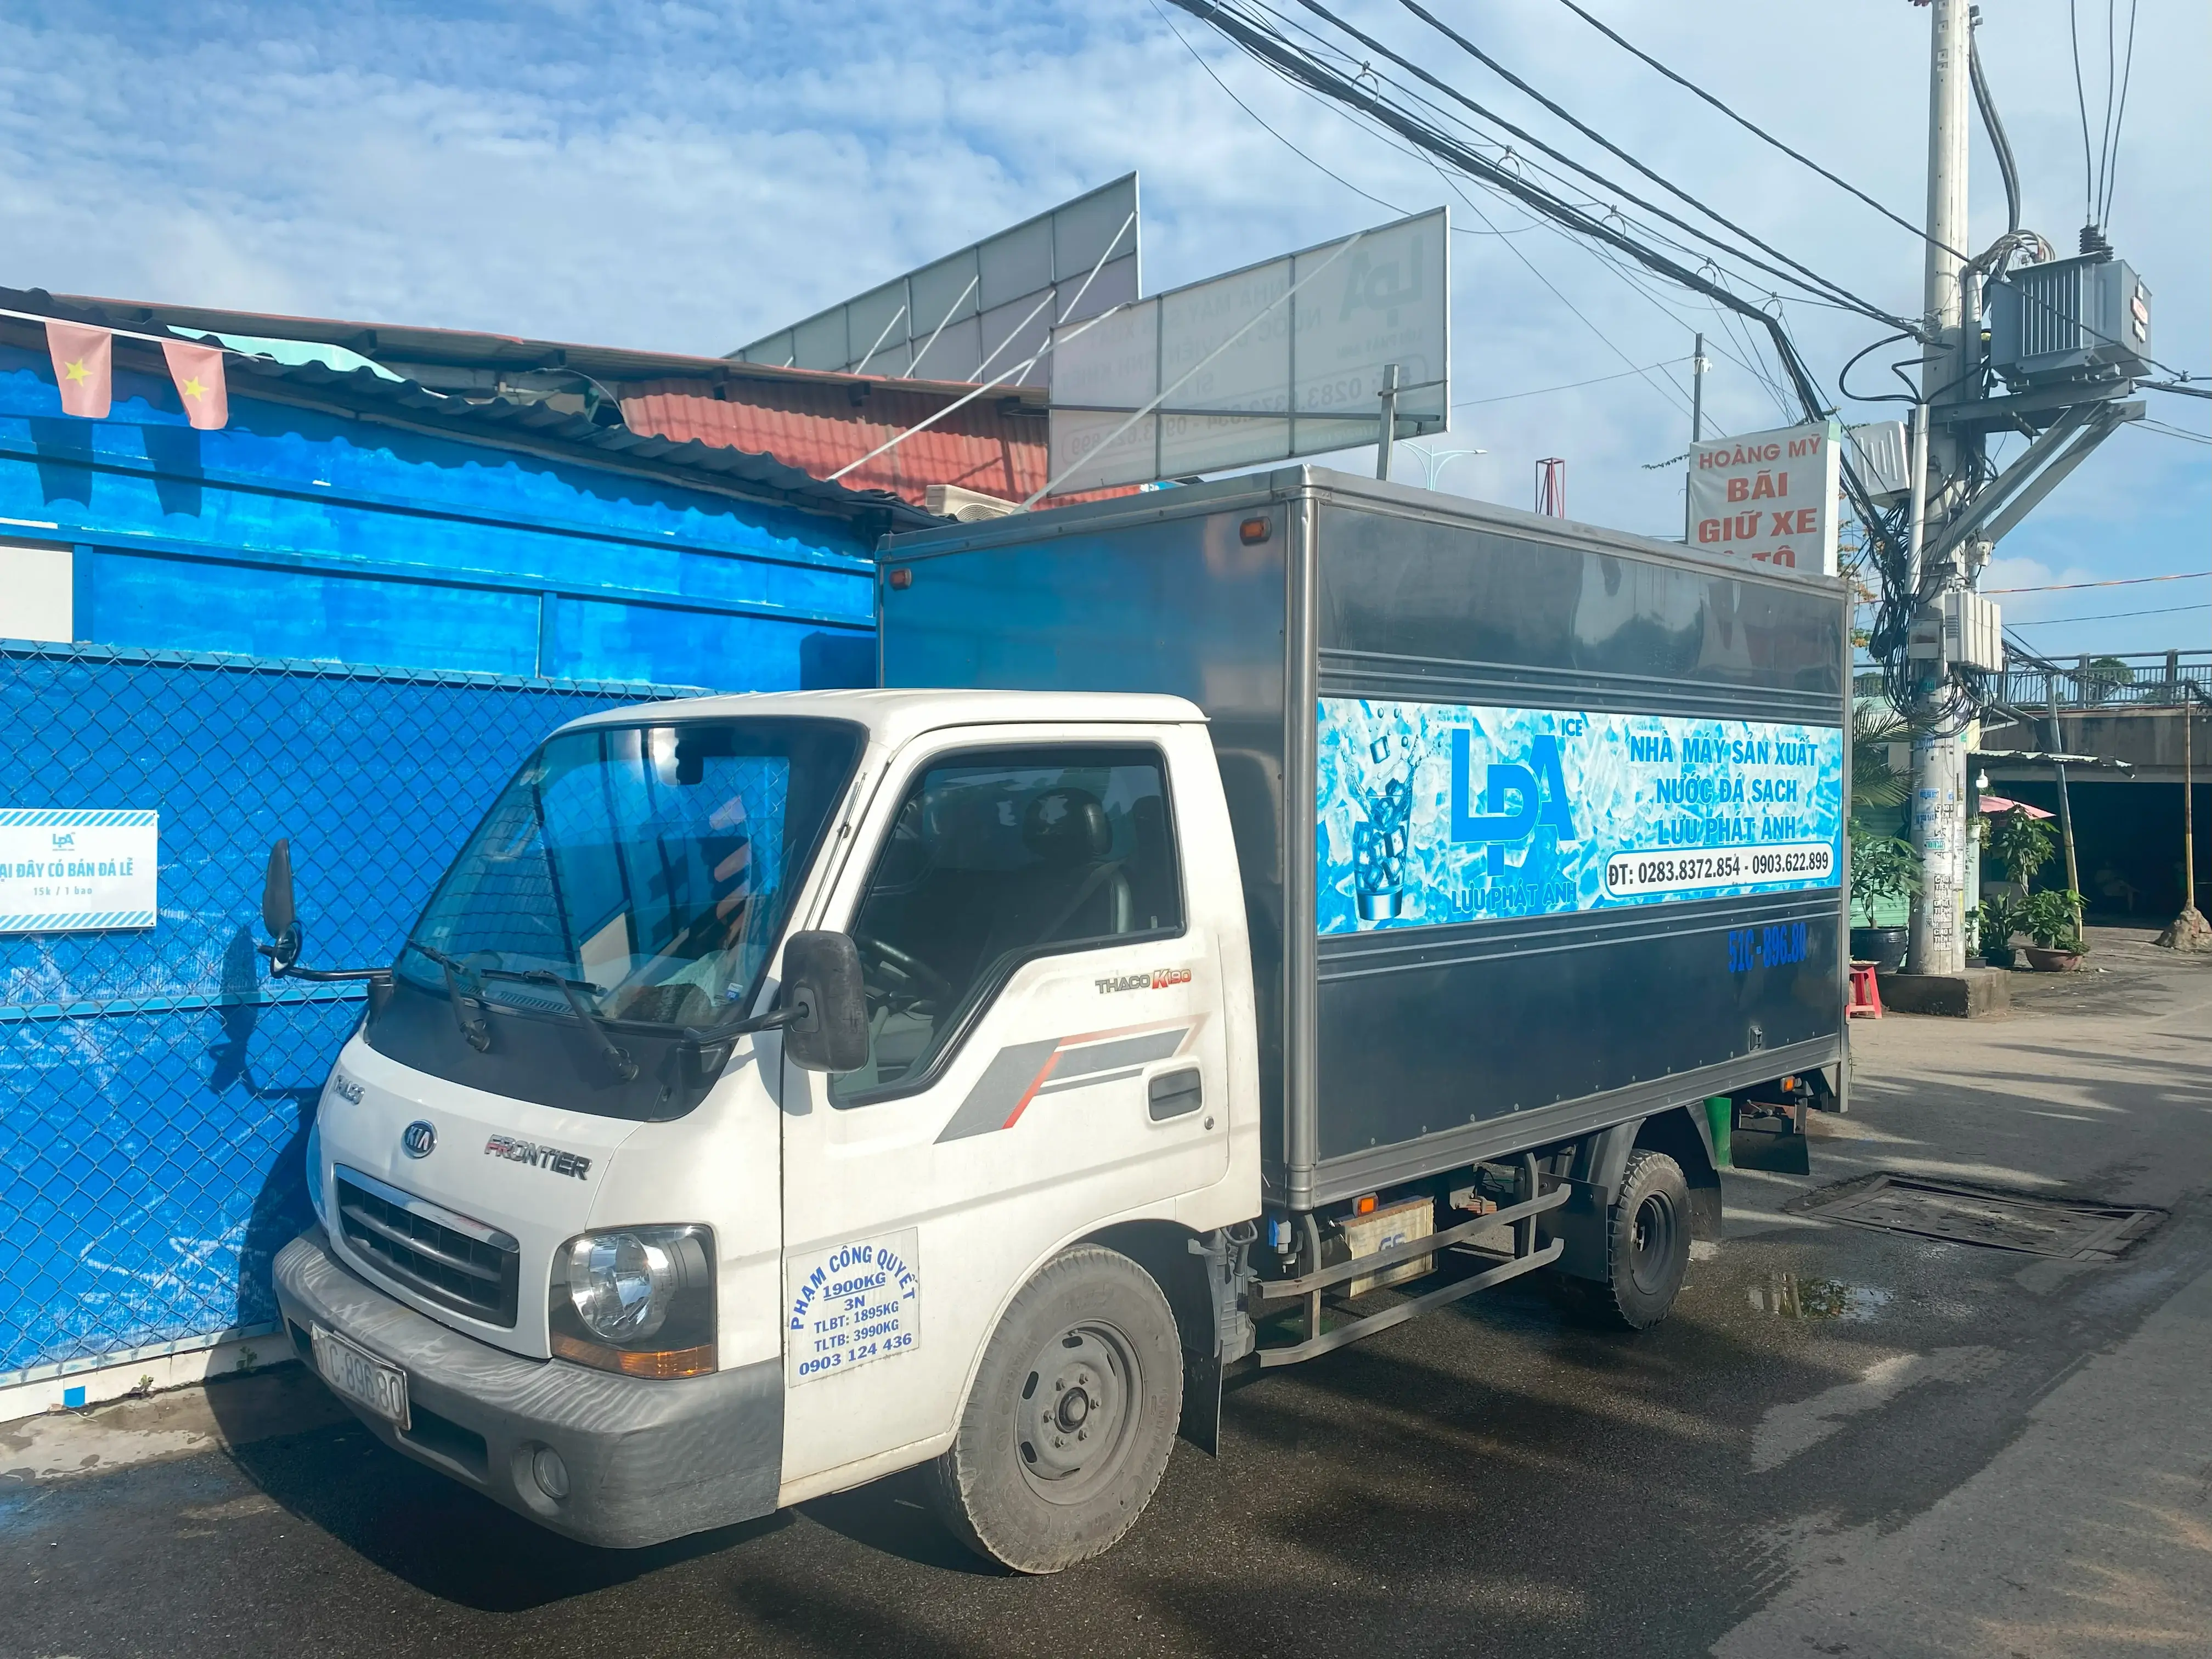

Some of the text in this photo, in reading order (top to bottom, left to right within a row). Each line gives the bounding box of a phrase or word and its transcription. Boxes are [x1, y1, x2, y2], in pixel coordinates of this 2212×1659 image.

[1700, 433, 1822, 470] HOÀNG MỸ
[1728, 469, 1788, 503] BÃI
[1699, 507, 1818, 543] GIỮ XE
[1561, 718, 1583, 737] ICE
[1630, 730, 1818, 766] NHÀ MÁY SẢN XUẤT
[1656, 771, 1797, 808] NƯỚC ĐÁ SẠCH
[1657, 810, 1796, 845] LƯU PHÁT ANH
[0, 863, 13, 882] ẠI
[16, 859, 45, 878] ĐÂY
[48, 859, 64, 877] CÓ
[67, 858, 95, 877] BÁN
[98, 858, 116, 876] ĐÁ
[1609, 862, 1634, 886] ĐT:
[1638, 855, 1741, 884] 0283.8372.854
[1752, 851, 1829, 874] 0903.622.899
[33, 887, 51, 896] 15k
[65, 887, 69, 895] 1
[74, 886, 93, 895] bao
[1491, 878, 1538, 910] PHÁT
[1542, 882, 1578, 905] ANH
[1096, 968, 1192, 994] THACO K190
[406, 1125, 431, 1151] KIA
[484, 1134, 592, 1181] FRONTIER
[791, 1245, 918, 1330] PHẠM CÔNG QUYẾT
[823, 1271, 886, 1299] 1900KG
[814, 1301, 899, 1334] TLBT: 1895KG
[844, 1295, 865, 1311] 3N
[814, 1319, 899, 1352] TLTB: 3990KG
[799, 1333, 912, 1375] 0903 124 436
